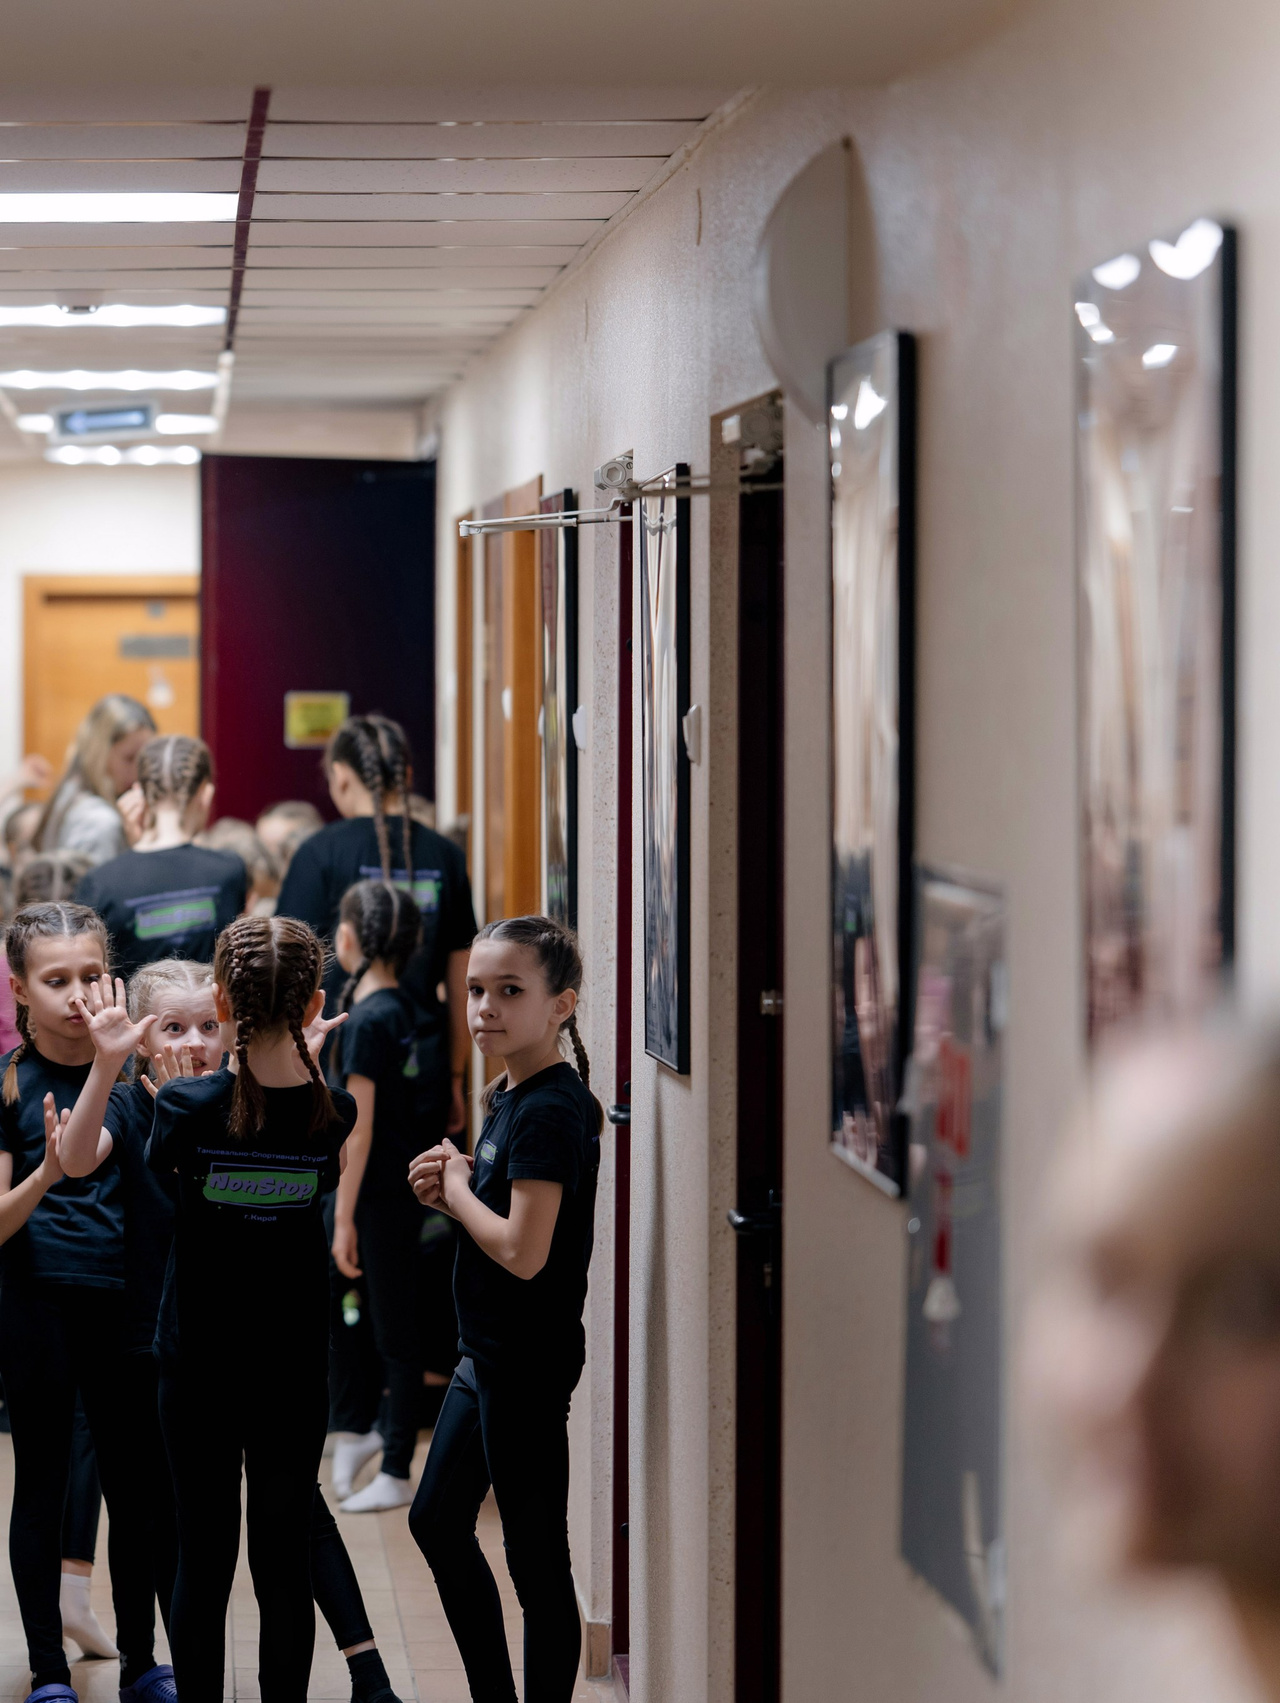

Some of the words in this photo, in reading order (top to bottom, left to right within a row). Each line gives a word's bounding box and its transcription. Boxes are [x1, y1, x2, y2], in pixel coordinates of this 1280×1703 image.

[196, 1146, 300, 1161] Танцевально-Спортивная
[209, 1172, 314, 1199] NonStop
[244, 1213, 277, 1223] г.Киров
